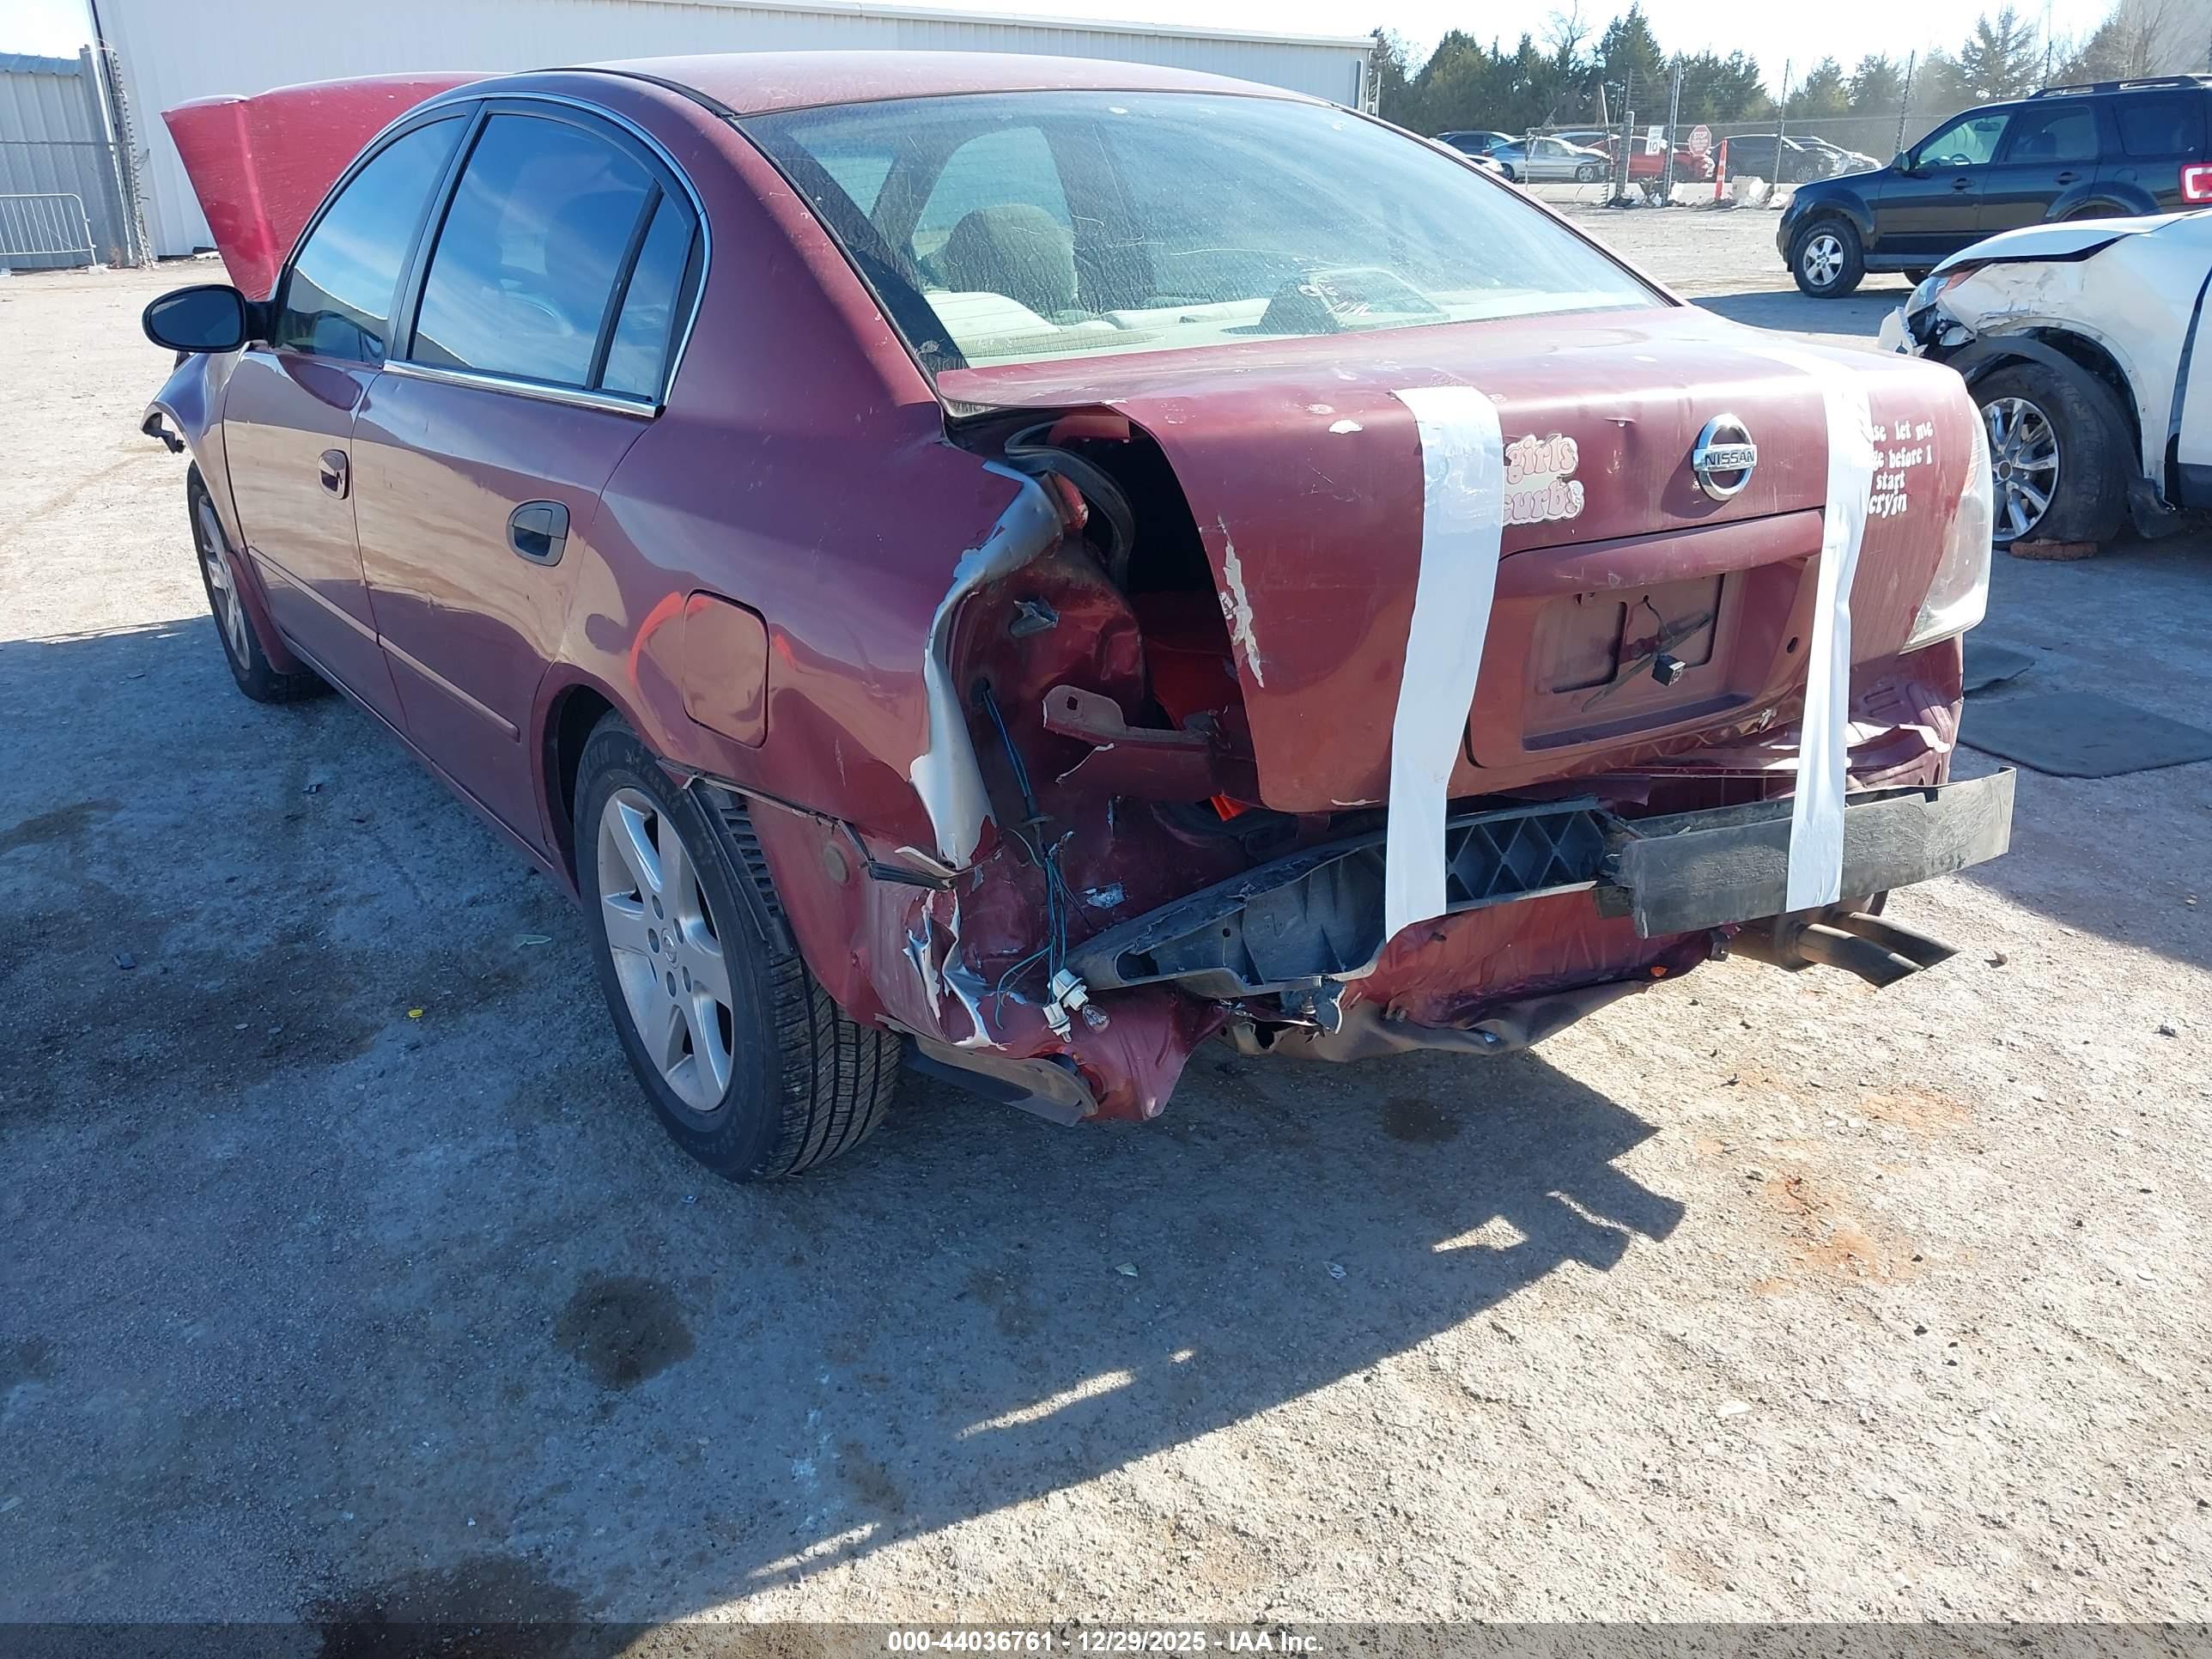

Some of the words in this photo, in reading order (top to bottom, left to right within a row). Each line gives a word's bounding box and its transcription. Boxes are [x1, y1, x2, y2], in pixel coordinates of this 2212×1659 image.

[1649, 142, 1658, 152] 10
[1894, 420, 1911, 441] let
[1915, 421, 1933, 441] me
[1507, 435, 1577, 484] girls
[1705, 452, 1754, 465] NISSAN
[1888, 447, 1923, 469] before
[1876, 470, 1905, 490] start
